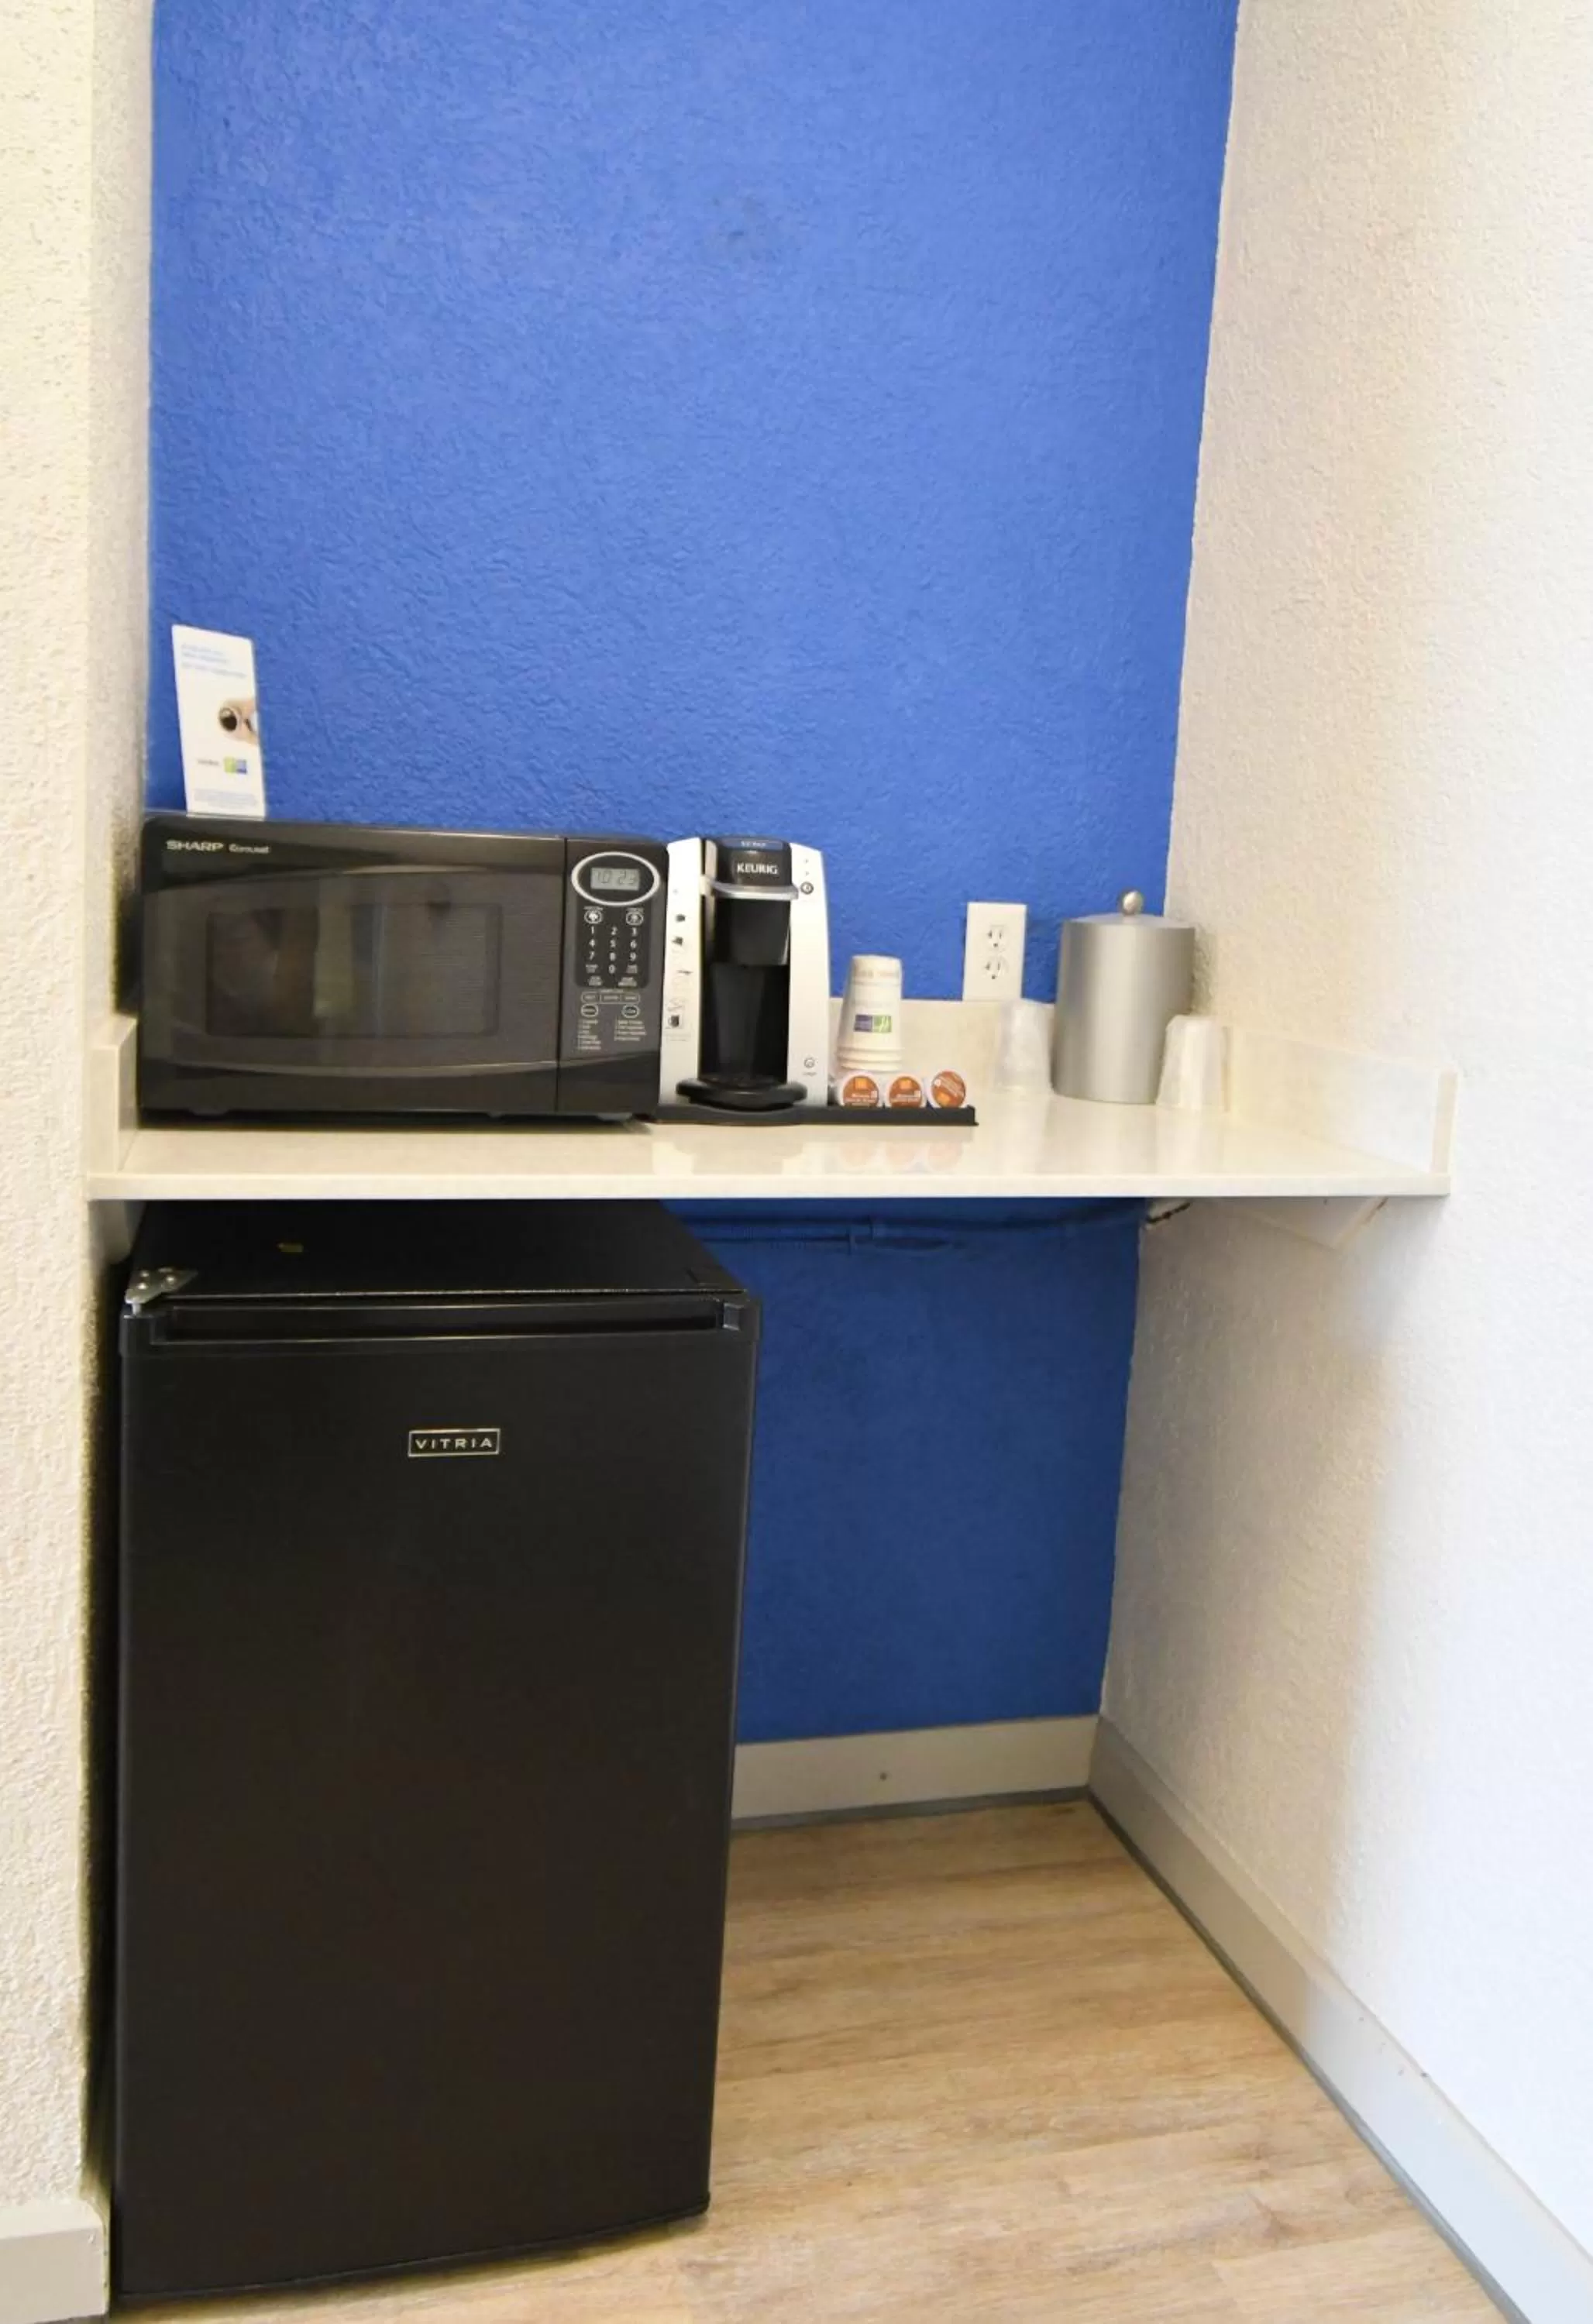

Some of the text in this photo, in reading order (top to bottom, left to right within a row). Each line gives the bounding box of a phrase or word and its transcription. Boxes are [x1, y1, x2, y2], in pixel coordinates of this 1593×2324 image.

[166, 840, 224, 851] SHARP
[737, 862, 778, 875] KEURIG
[415, 1437, 493, 1449] VITRIA
